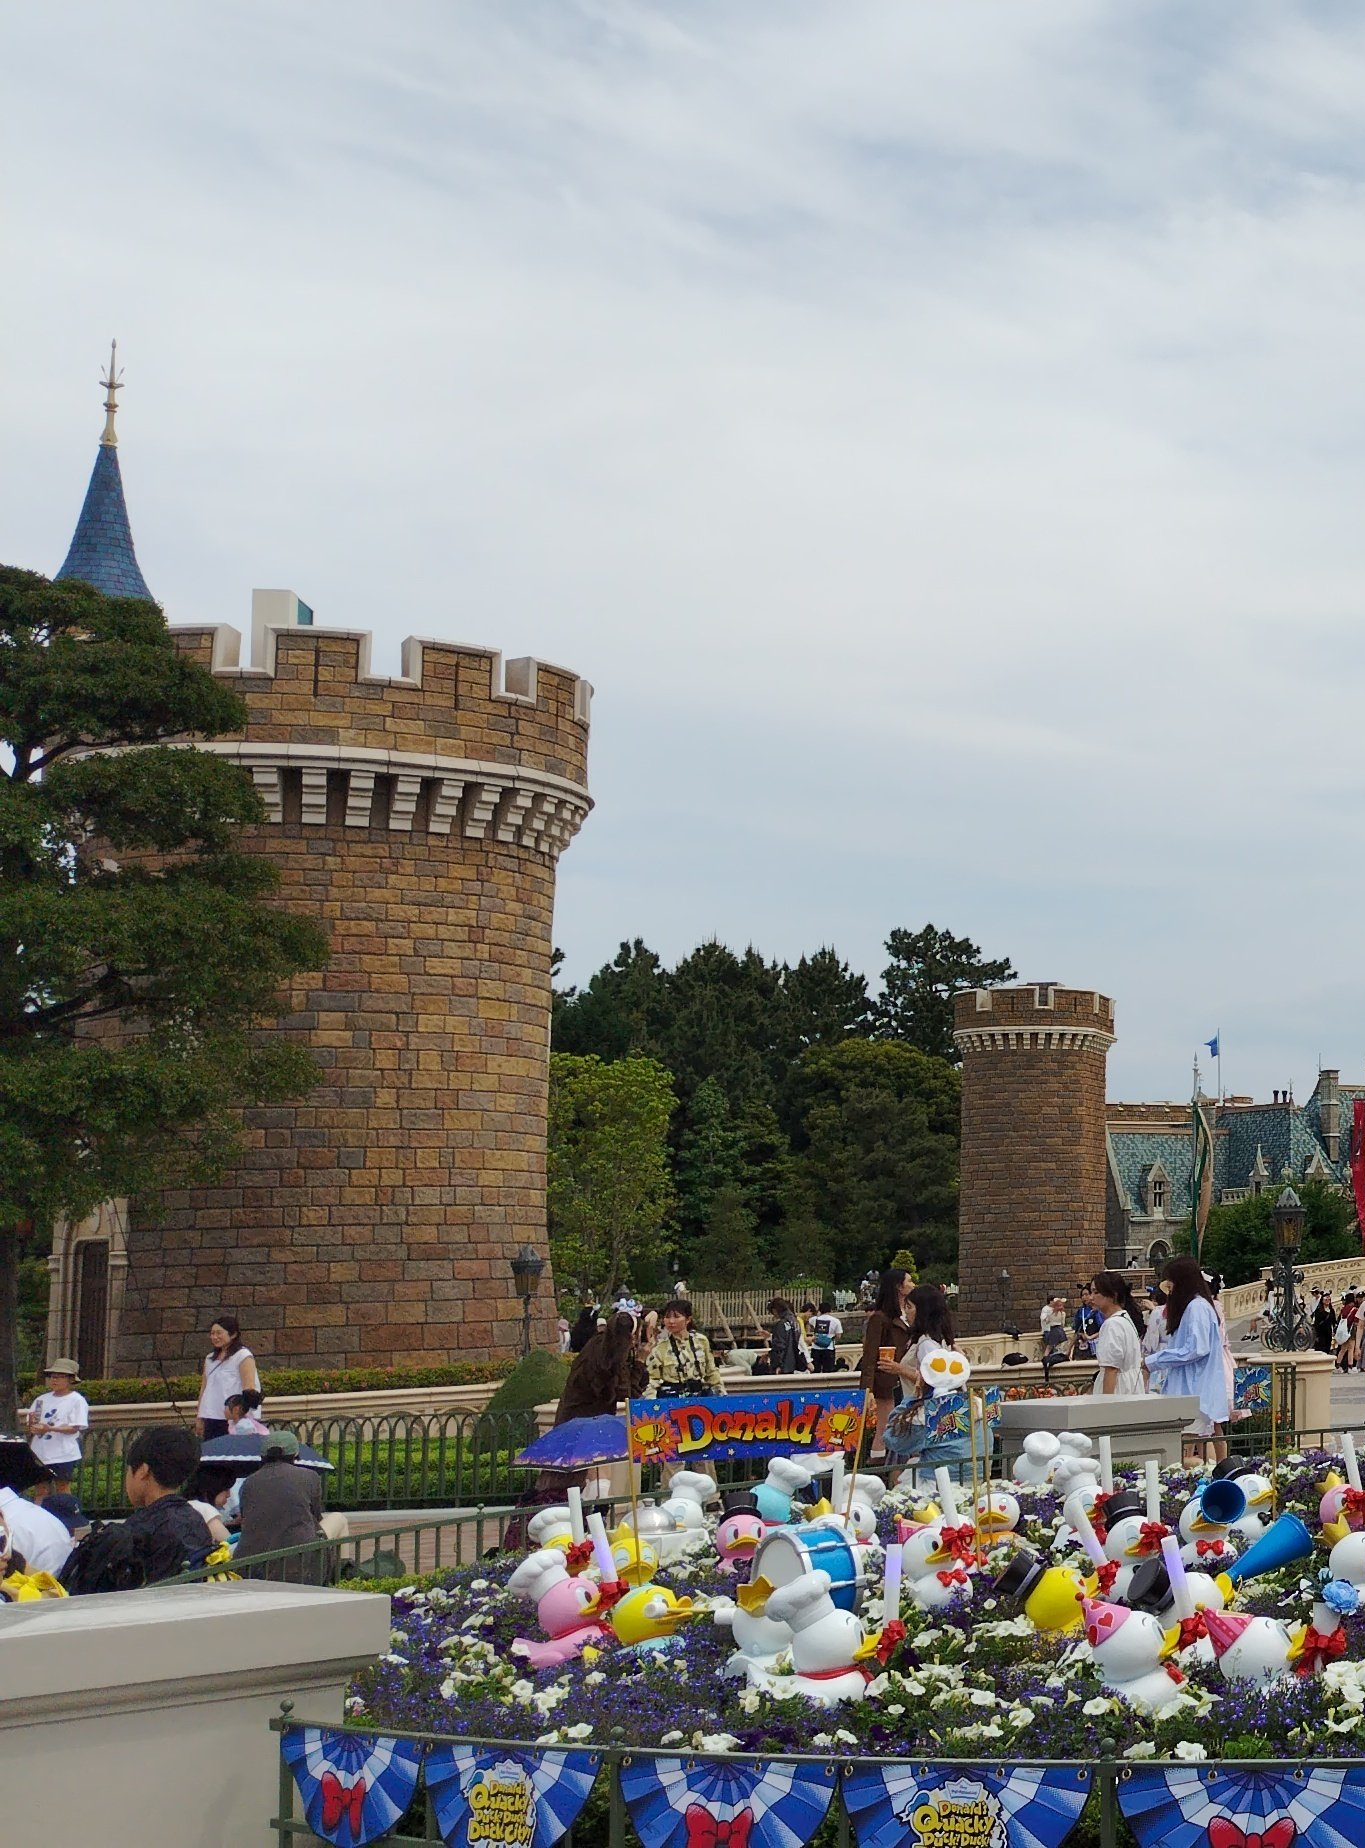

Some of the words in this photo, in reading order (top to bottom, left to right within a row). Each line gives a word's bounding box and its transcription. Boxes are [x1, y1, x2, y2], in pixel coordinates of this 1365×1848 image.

[670, 1400, 822, 1454] Donald
[913, 1805, 995, 1834] Quacky
[938, 1800, 988, 1816] Donald's
[469, 1820, 504, 1841] Duck
